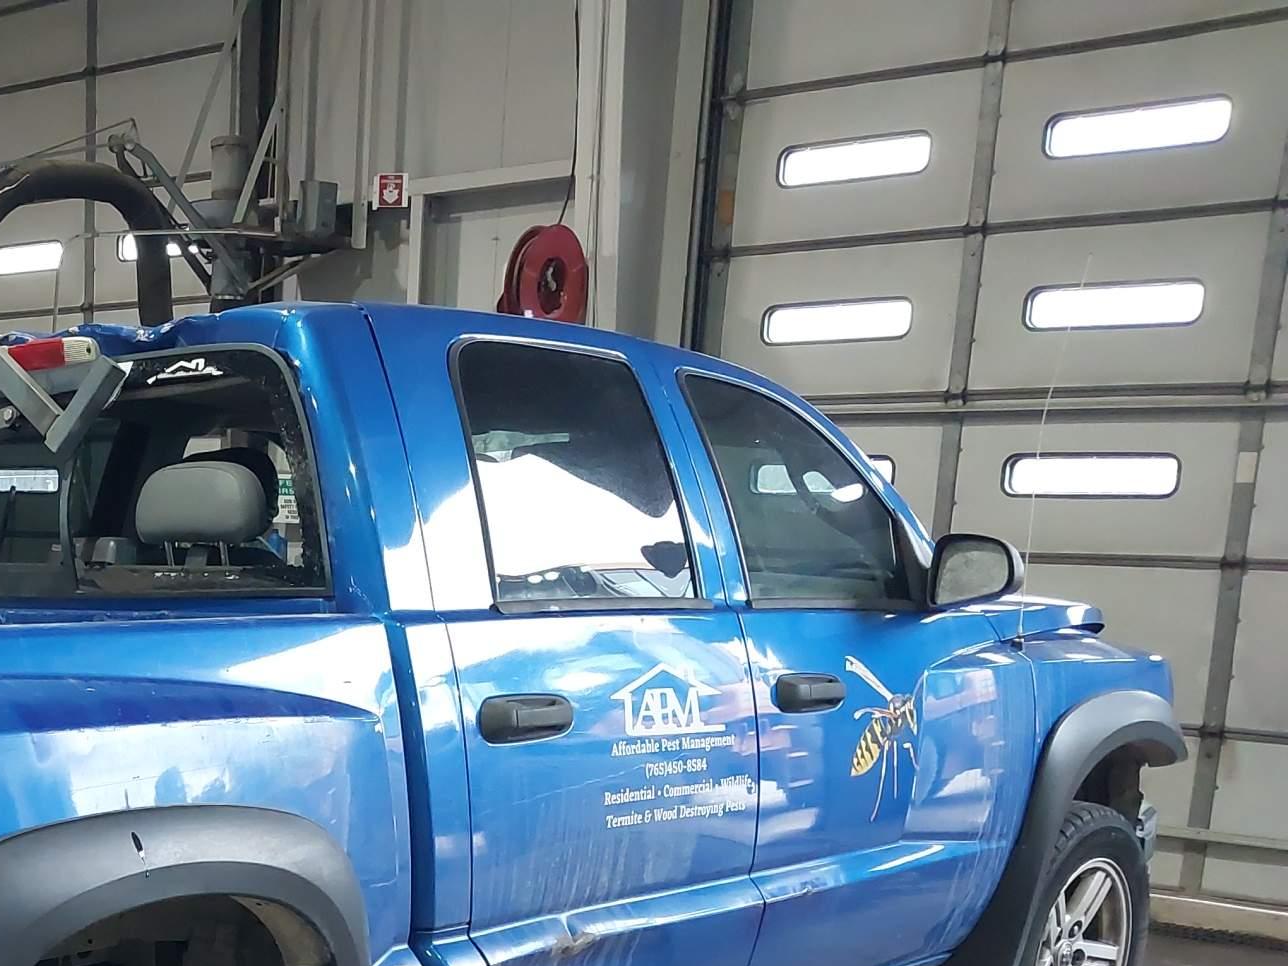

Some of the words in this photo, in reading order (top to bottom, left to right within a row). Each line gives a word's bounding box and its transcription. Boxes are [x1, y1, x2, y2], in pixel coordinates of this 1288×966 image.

[611, 740, 659, 757] Affordable
[661, 738, 680, 752] Pest
[681, 734, 736, 752] Management
[645, 757, 708, 779] (765)450-8584
[604, 784, 655, 806] Residential
[663, 778, 713, 798] Commercial
[605, 810, 643, 829] Termite
[644, 810, 652, 824] &
[653, 805, 678, 822] Wood
[679, 800, 724, 819] Destroying
[725, 798, 746, 813] Pests
